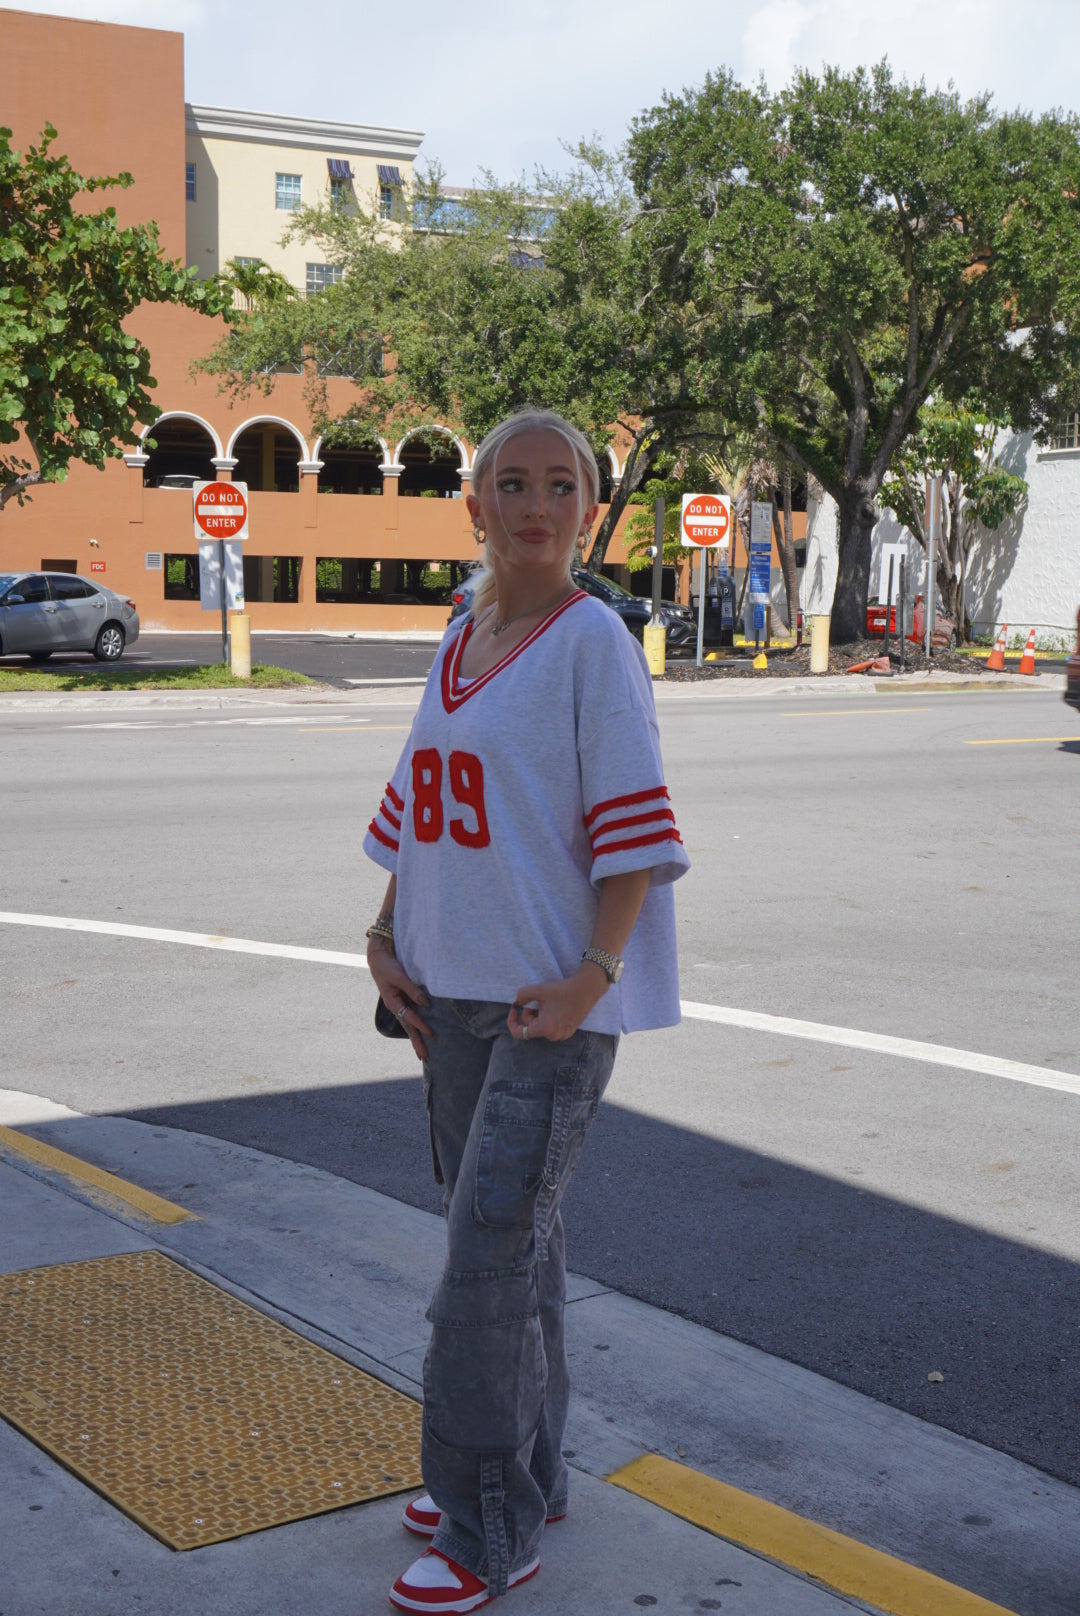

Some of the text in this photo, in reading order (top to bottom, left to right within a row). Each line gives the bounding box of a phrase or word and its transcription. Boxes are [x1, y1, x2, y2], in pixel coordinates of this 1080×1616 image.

[202, 493, 239, 503] DO NOT
[690, 504, 723, 514] DO NOT
[206, 518, 236, 528] ENTER
[692, 527, 719, 537] ENTER
[411, 747, 491, 849] 89
